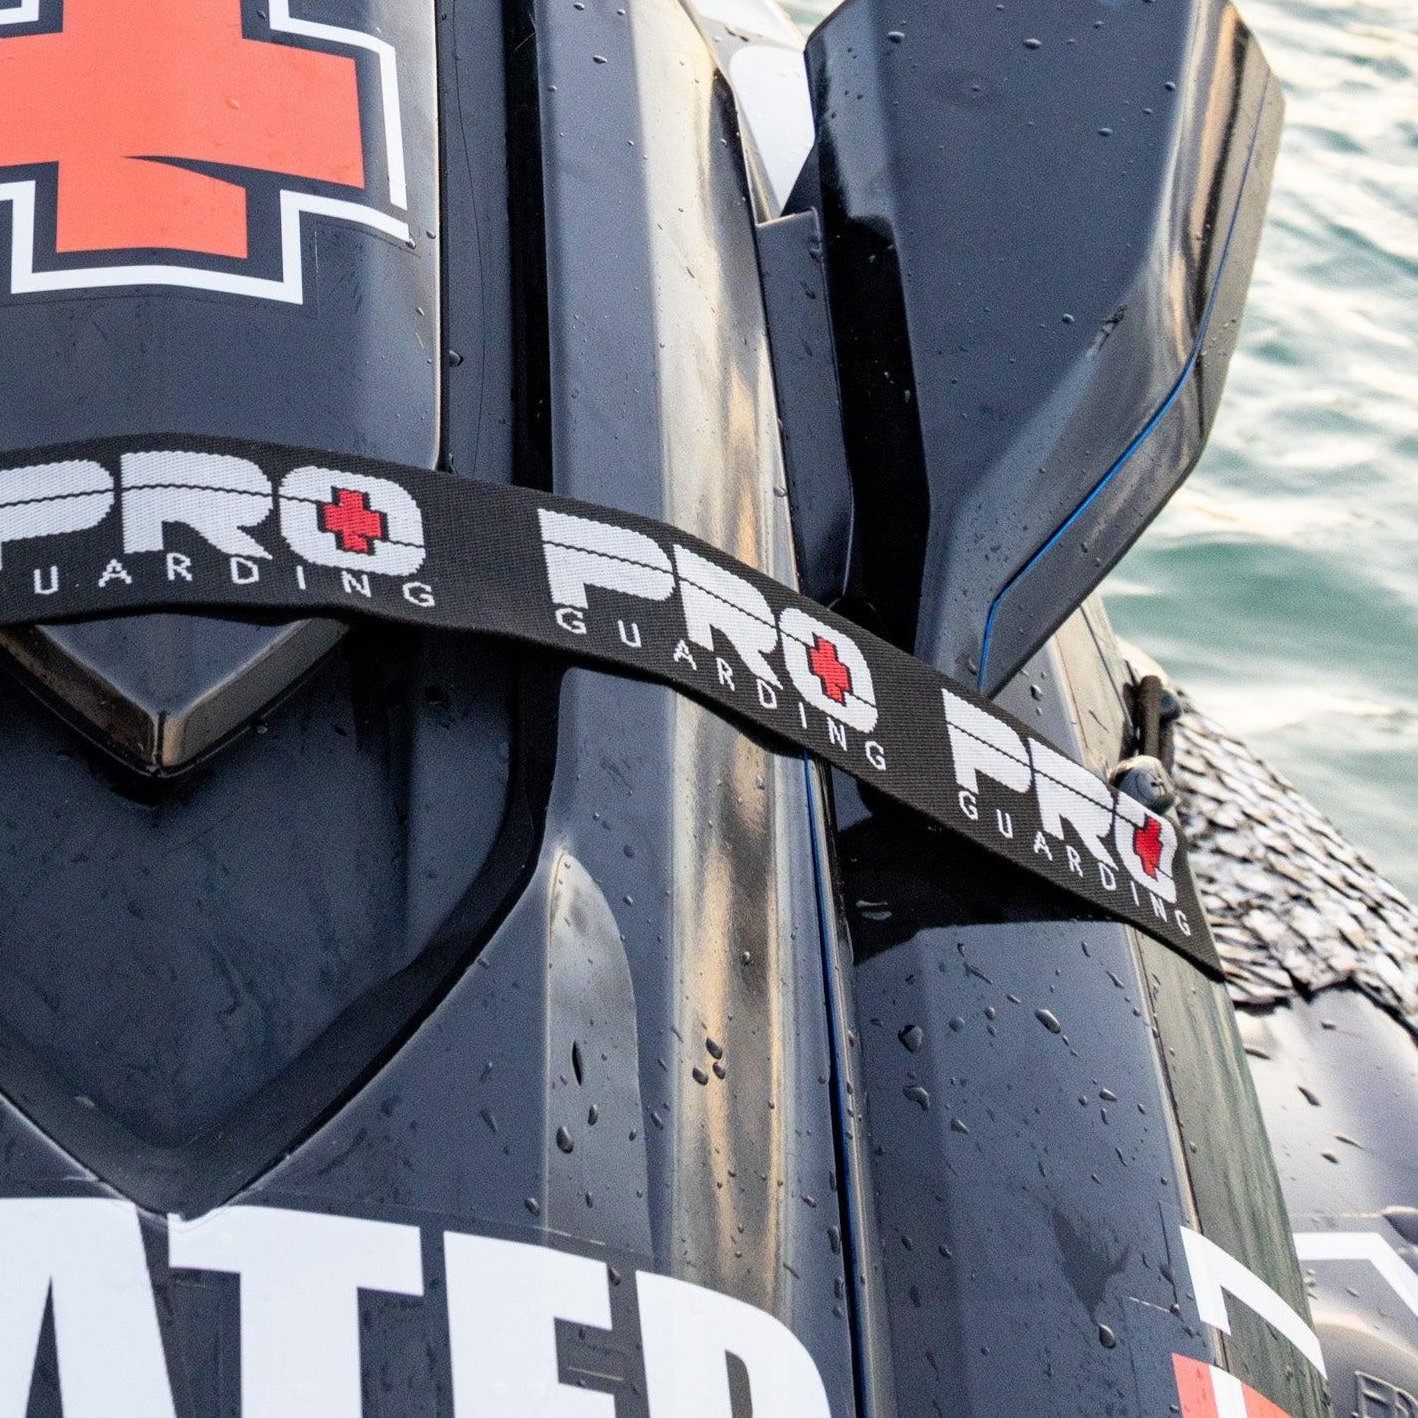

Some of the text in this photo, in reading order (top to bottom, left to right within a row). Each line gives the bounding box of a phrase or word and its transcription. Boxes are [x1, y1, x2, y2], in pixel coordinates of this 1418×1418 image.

[538, 508, 879, 733] PRO
[555, 608, 887, 772] GUARDING
[941, 688, 1178, 904] PRO
[958, 790, 1191, 936] GUARDING
